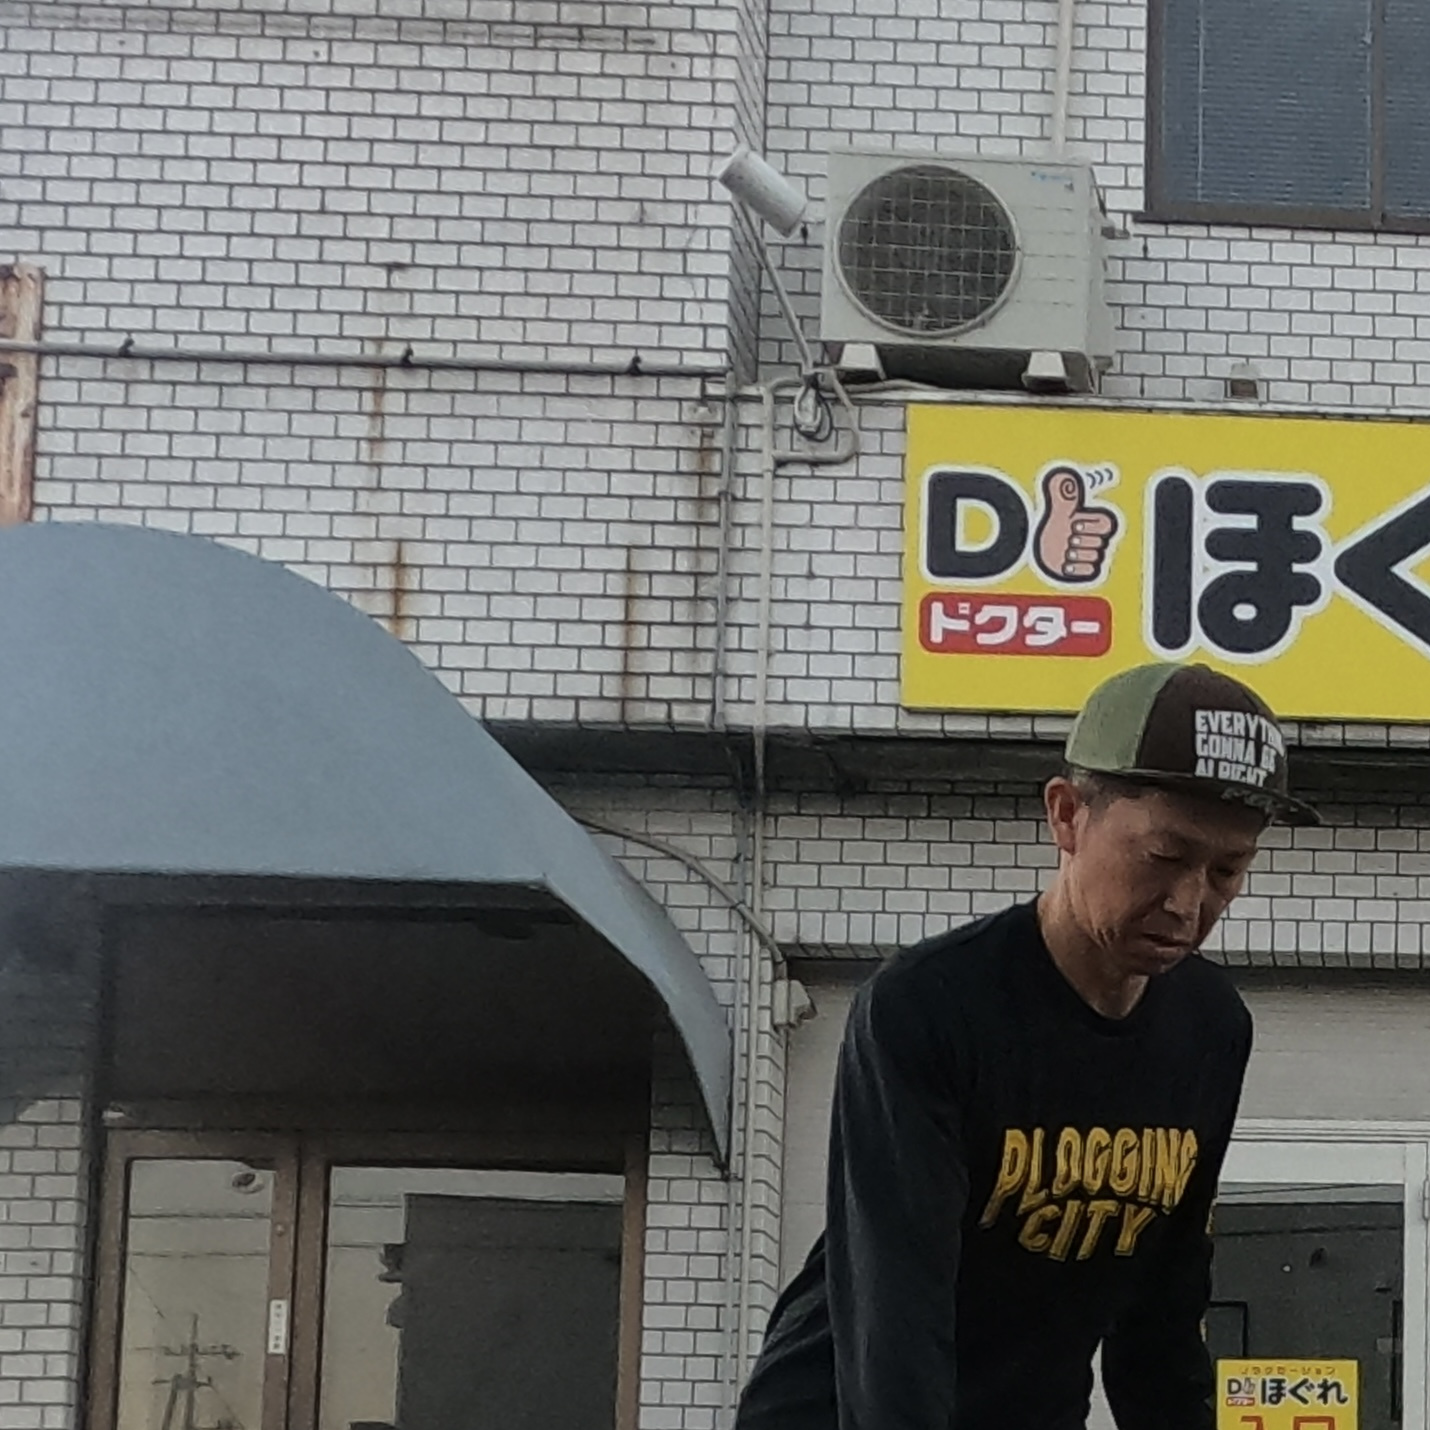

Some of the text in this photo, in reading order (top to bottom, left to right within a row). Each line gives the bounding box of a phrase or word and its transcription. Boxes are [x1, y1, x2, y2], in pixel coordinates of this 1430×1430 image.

[930, 601, 1100, 646] ドクター
[1195, 710, 1285, 758] EVERYT
[1195, 733, 1256, 766] GONNA
[978, 1127, 1198, 1229] PLOGGING
[1018, 1200, 1157, 1262] CITY
[1261, 1377, 1348, 1405] ほぐれ
